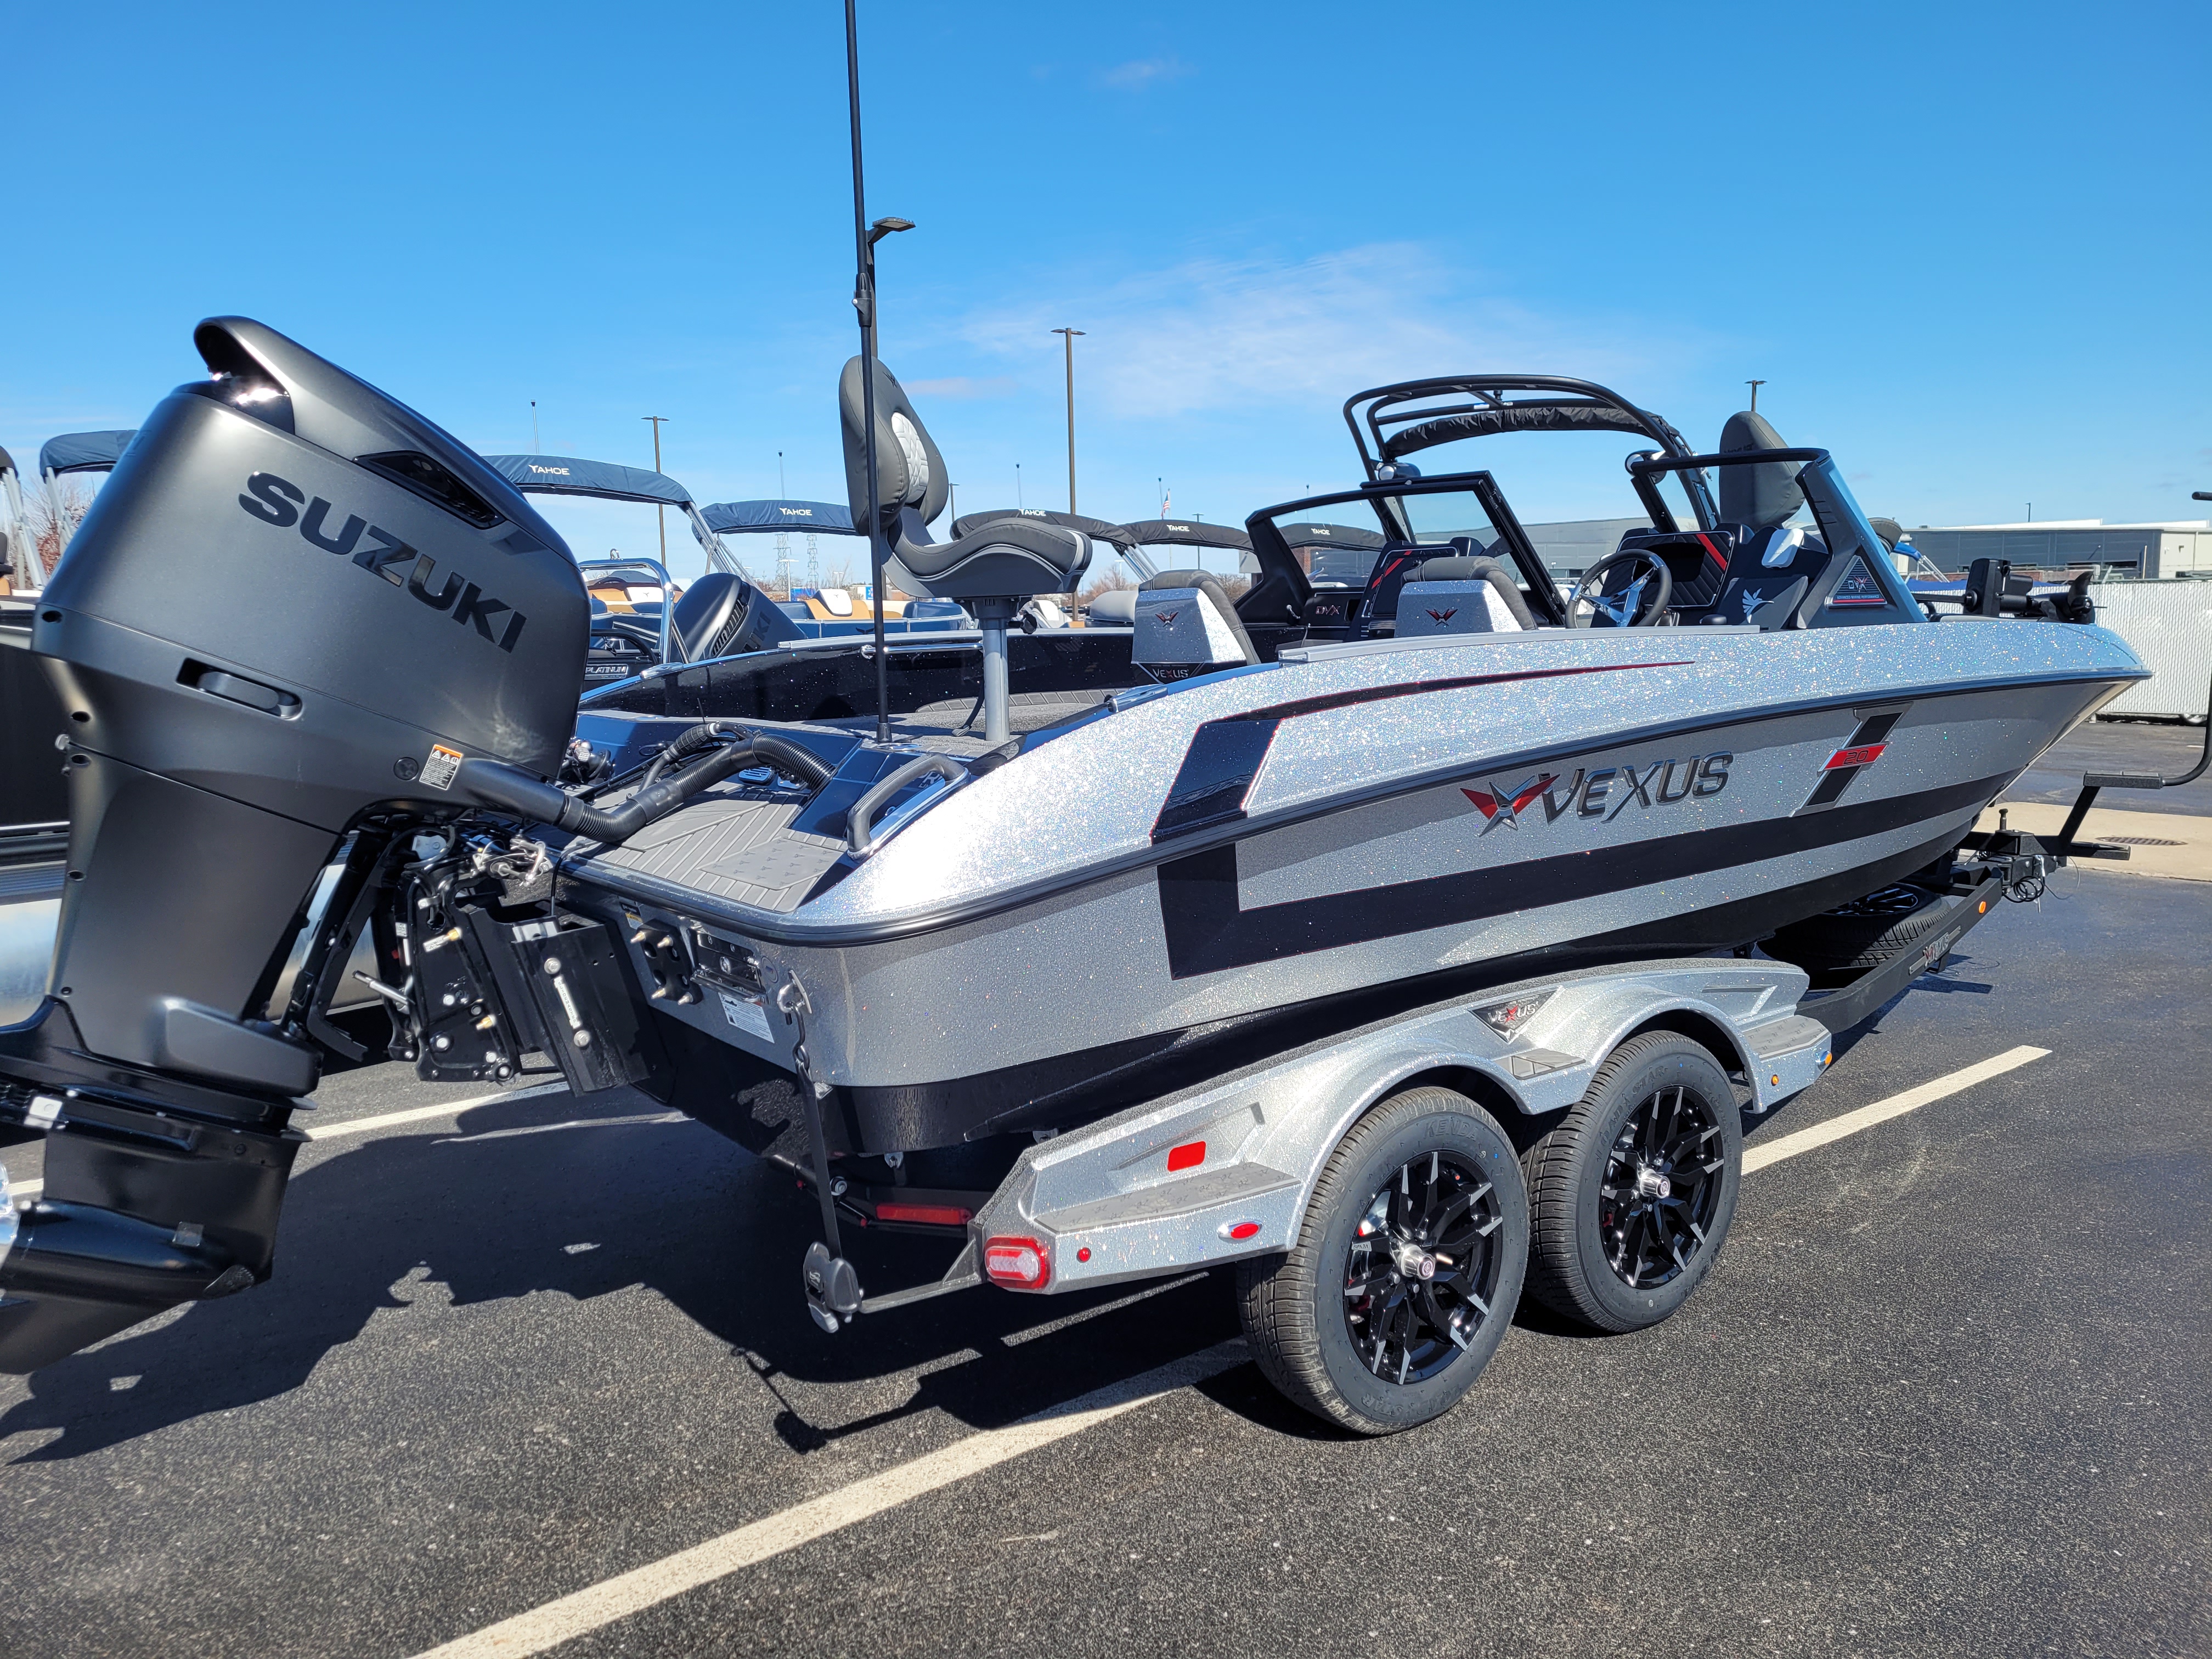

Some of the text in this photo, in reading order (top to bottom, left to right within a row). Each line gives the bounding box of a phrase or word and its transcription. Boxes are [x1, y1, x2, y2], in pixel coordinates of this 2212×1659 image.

[528, 464, 570, 475] TAHOE
[779, 507, 812, 516] TAHOE
[239, 472, 527, 653] SUZUKI
[1152, 668, 1189, 679] VEXUS
[1843, 749, 1869, 765] 20
[1538, 751, 1734, 823] VEXUS
[1487, 1003, 1537, 1025] VEXUS
[1423, 1119, 1476, 1142] KENDA
